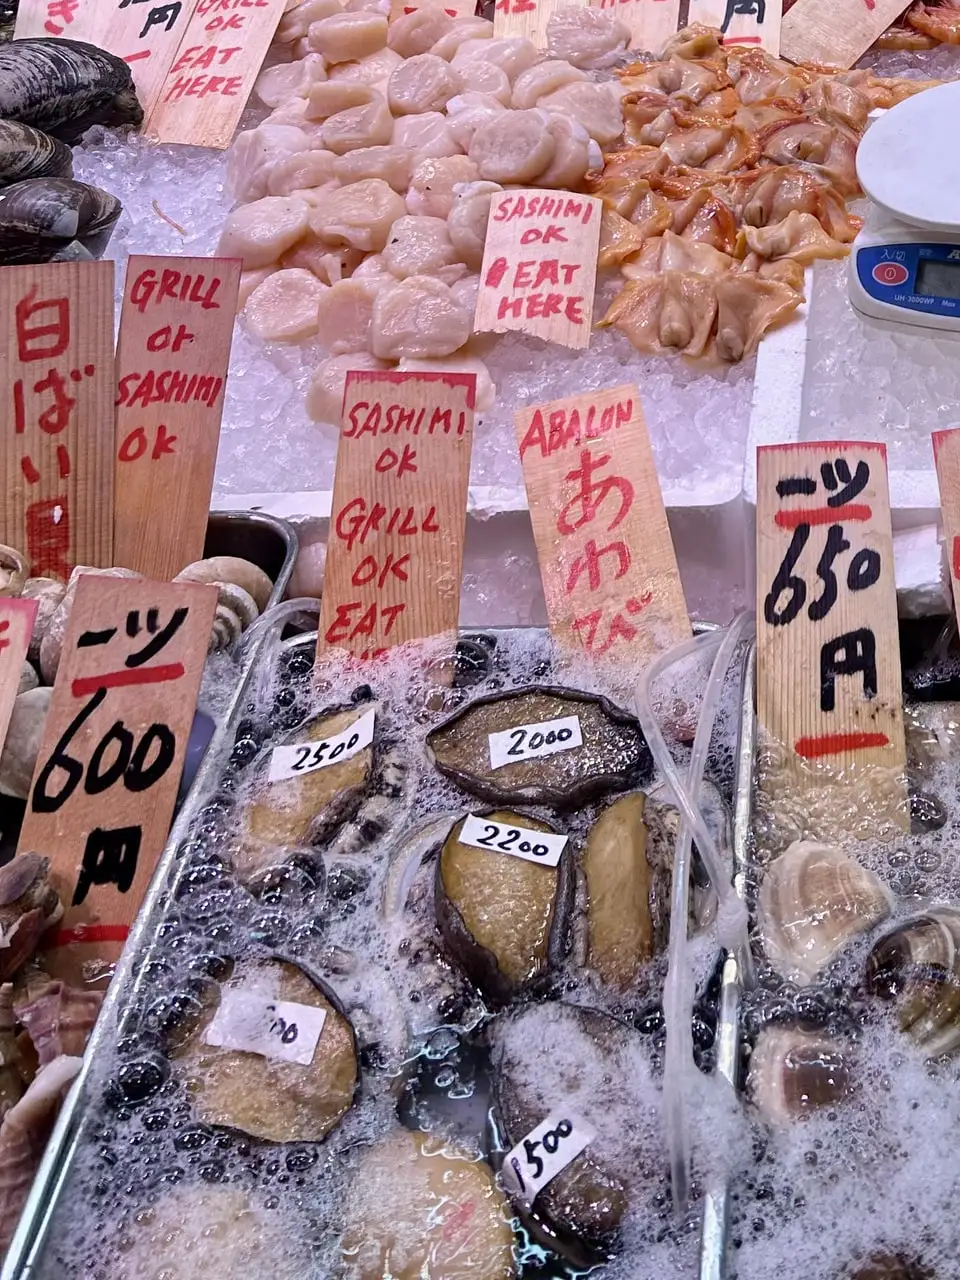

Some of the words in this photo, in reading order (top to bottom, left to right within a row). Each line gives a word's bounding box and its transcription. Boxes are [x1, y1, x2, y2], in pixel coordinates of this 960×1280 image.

[170, 45, 243, 75] EAT
[163, 75, 243, 103] HERE
[493, 196, 593, 224] SASHIMI
[520, 225, 568, 245] OK
[130, 269, 220, 312] GRILL
[497, 293, 584, 325] HERE
[115, 369, 223, 408] SASHIMI
[342, 401, 465, 440] SASHIMI
[518, 398, 634, 464] ABALON
[335, 497, 440, 551] GRILL
[352, 553, 410, 588] OK
[556, 449, 653, 656] あわび
[765, 522, 881, 626] 650
[325, 601, 405, 644] EAT
[819, 627, 878, 712] 円
[32, 686, 176, 814] 600
[291, 732, 360, 772] 2500
[507, 726, 573, 757] 2000
[476, 823, 550, 856] 2200
[72, 825, 142, 906] 円
[514, 1119, 573, 1191] 1500
